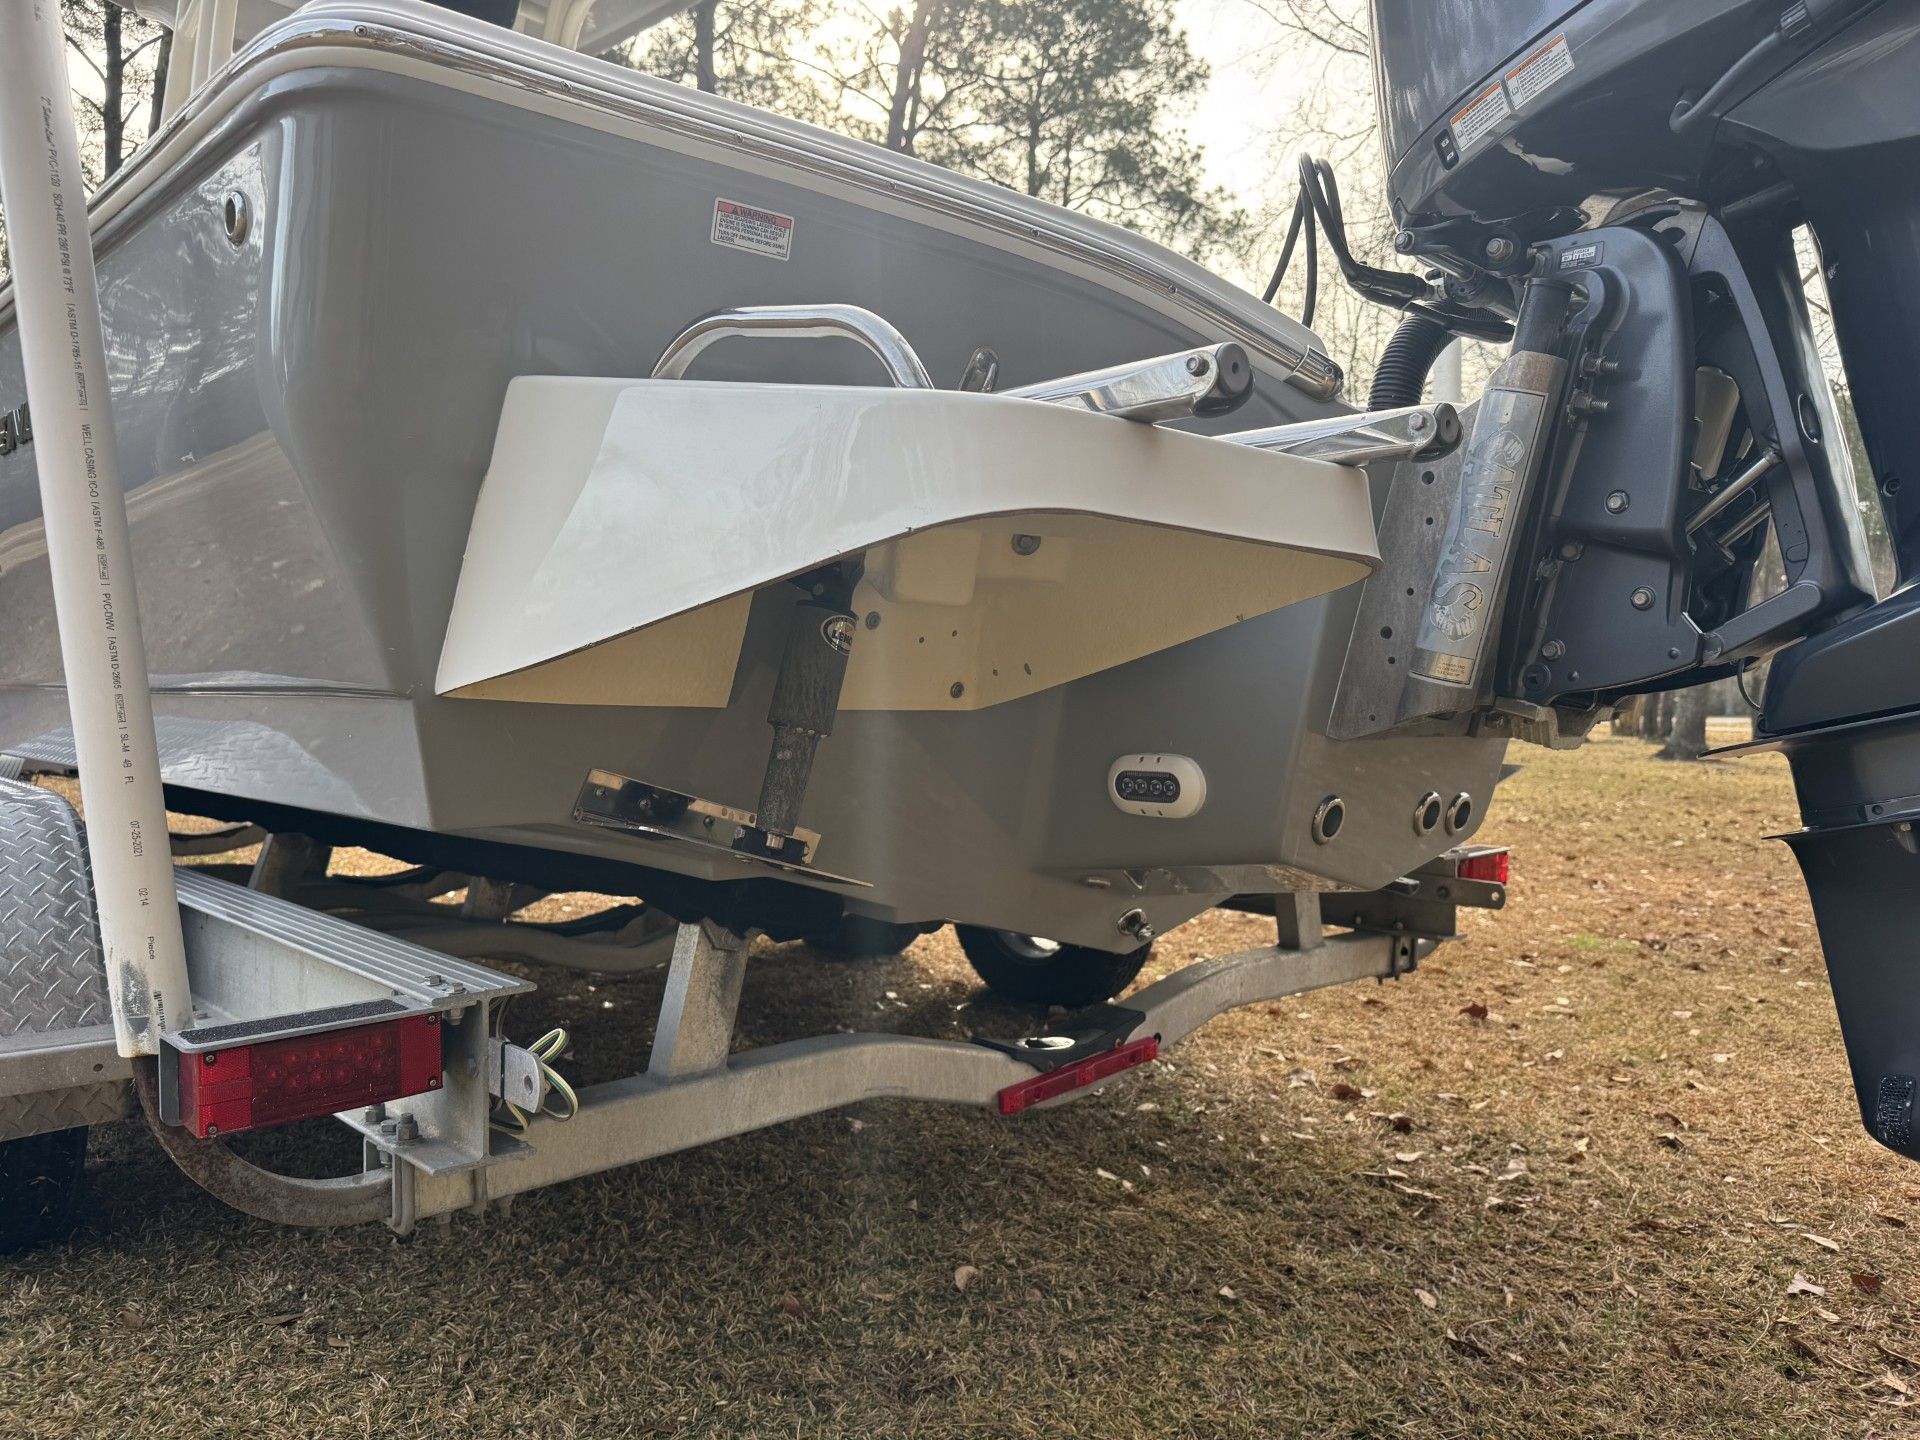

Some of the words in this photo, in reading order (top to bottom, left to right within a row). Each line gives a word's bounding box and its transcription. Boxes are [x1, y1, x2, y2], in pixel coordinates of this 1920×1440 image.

[741, 208, 777, 225] WARNING
[60, 252, 71, 266] PSI
[82, 423, 93, 446] WELL
[84, 447, 97, 479] CASING
[1430, 449, 1516, 612] ATLAS
[102, 593, 115, 631] PVC-DWV
[129, 820, 143, 857] 07-25-2021
